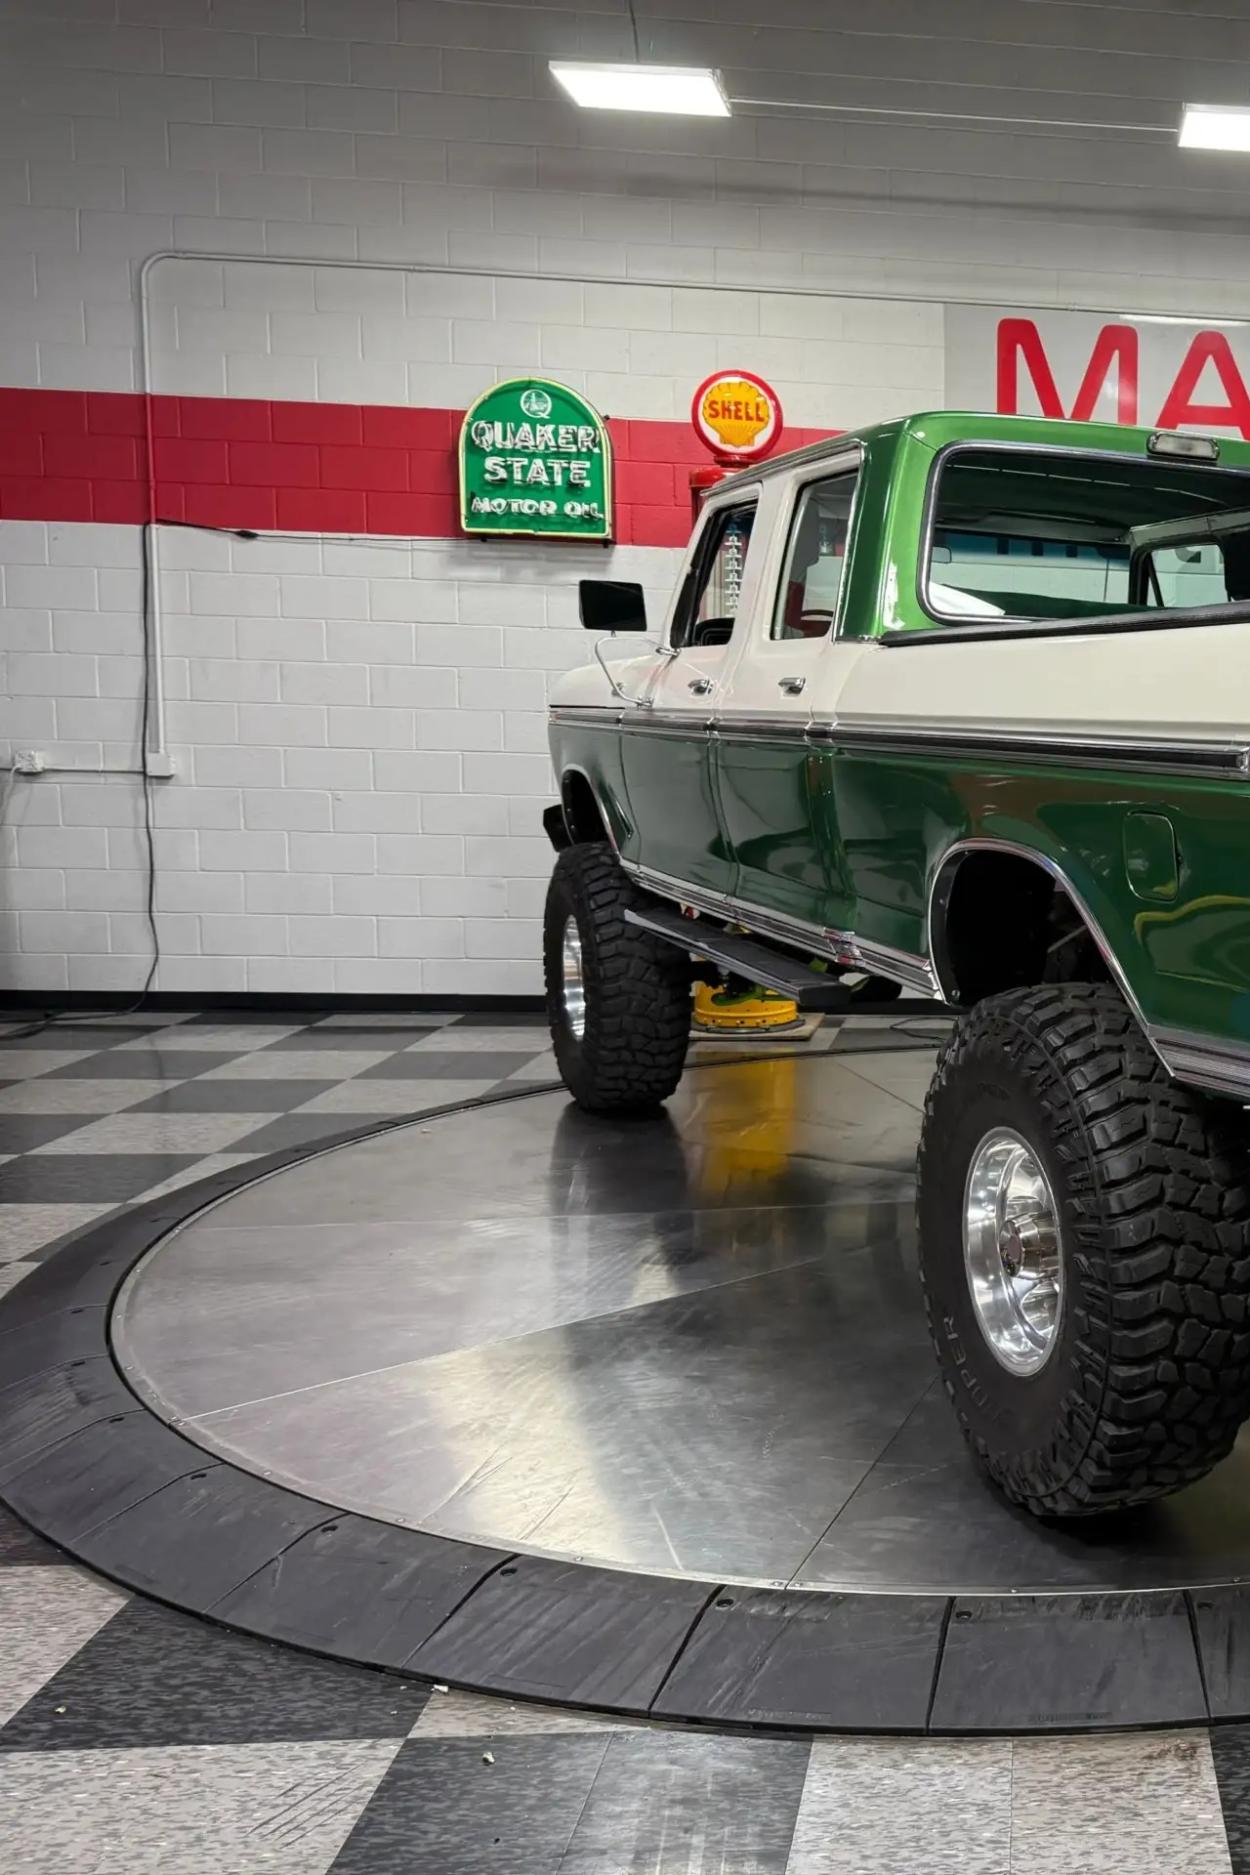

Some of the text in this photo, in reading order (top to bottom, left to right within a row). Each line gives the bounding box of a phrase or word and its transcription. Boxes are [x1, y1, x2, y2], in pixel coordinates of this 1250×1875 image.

[707, 399, 766, 423] SHELL
[471, 420, 601, 454] QUAKER
[483, 456, 591, 488] STATE
[471, 497, 605, 519] MOTOR OIL
